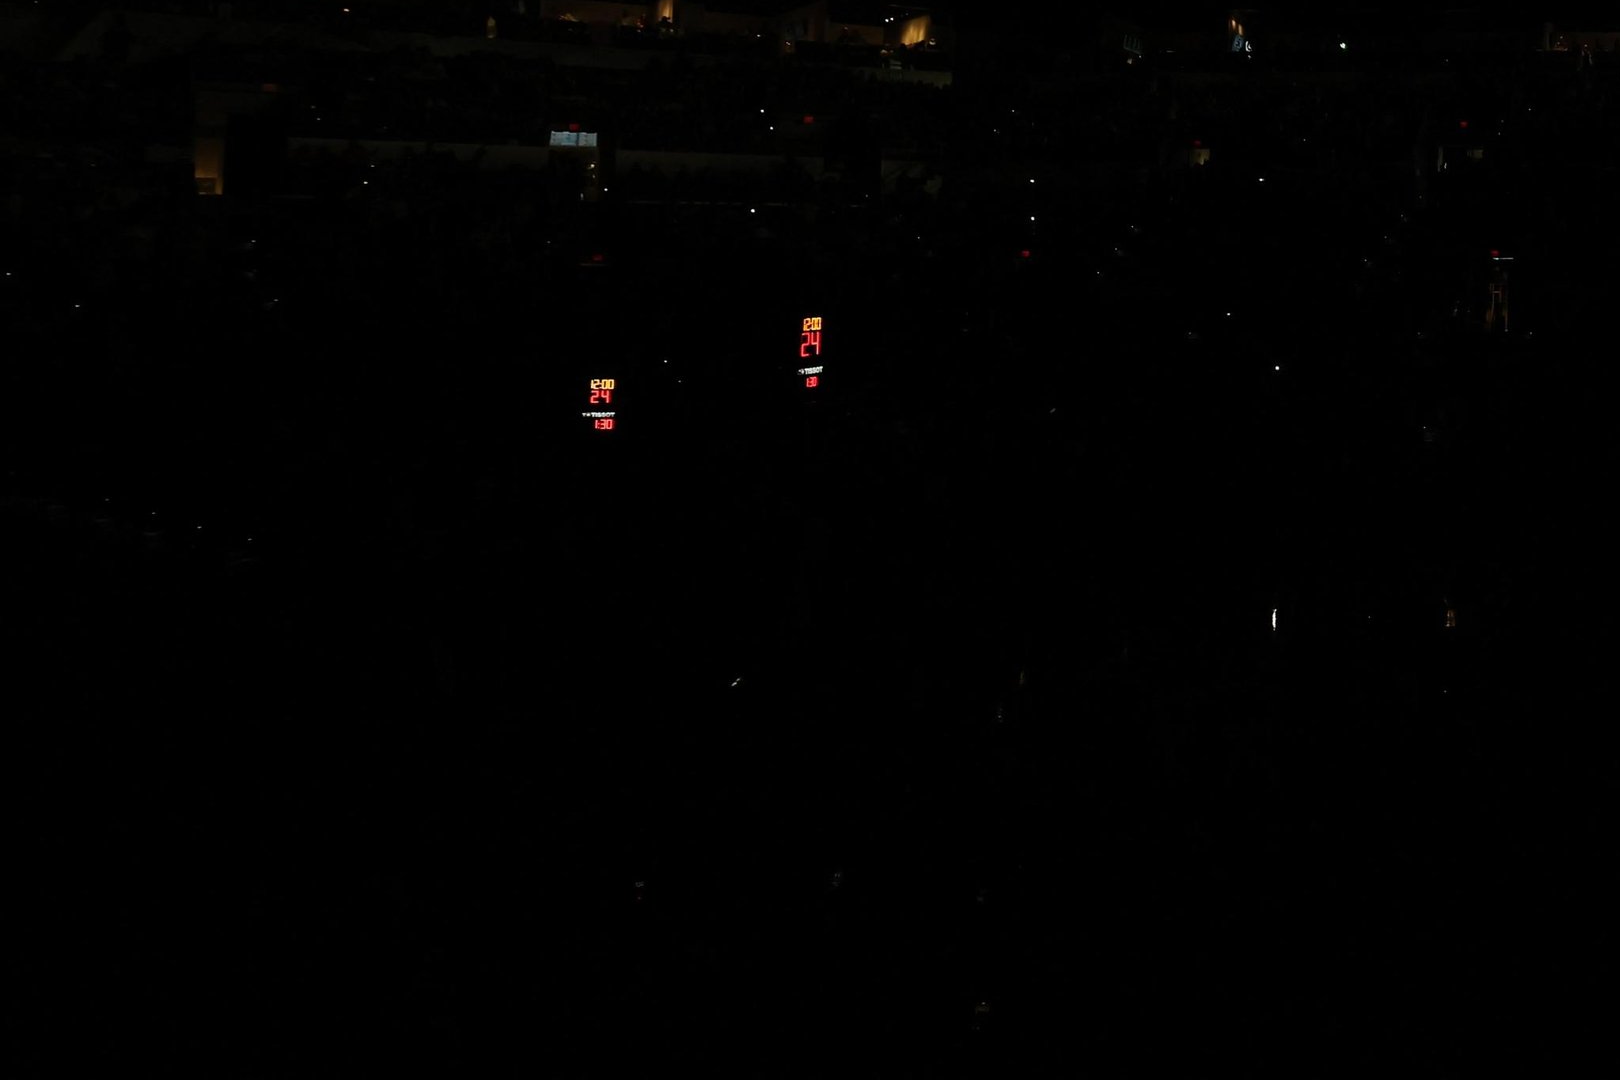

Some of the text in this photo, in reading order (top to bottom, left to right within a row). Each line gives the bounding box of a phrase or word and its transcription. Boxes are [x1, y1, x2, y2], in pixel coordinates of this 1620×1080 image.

[800, 331, 820, 357] 24
[590, 379, 615, 390] 12:00
[590, 390, 610, 403] 24
[594, 419, 613, 430] 1:30
